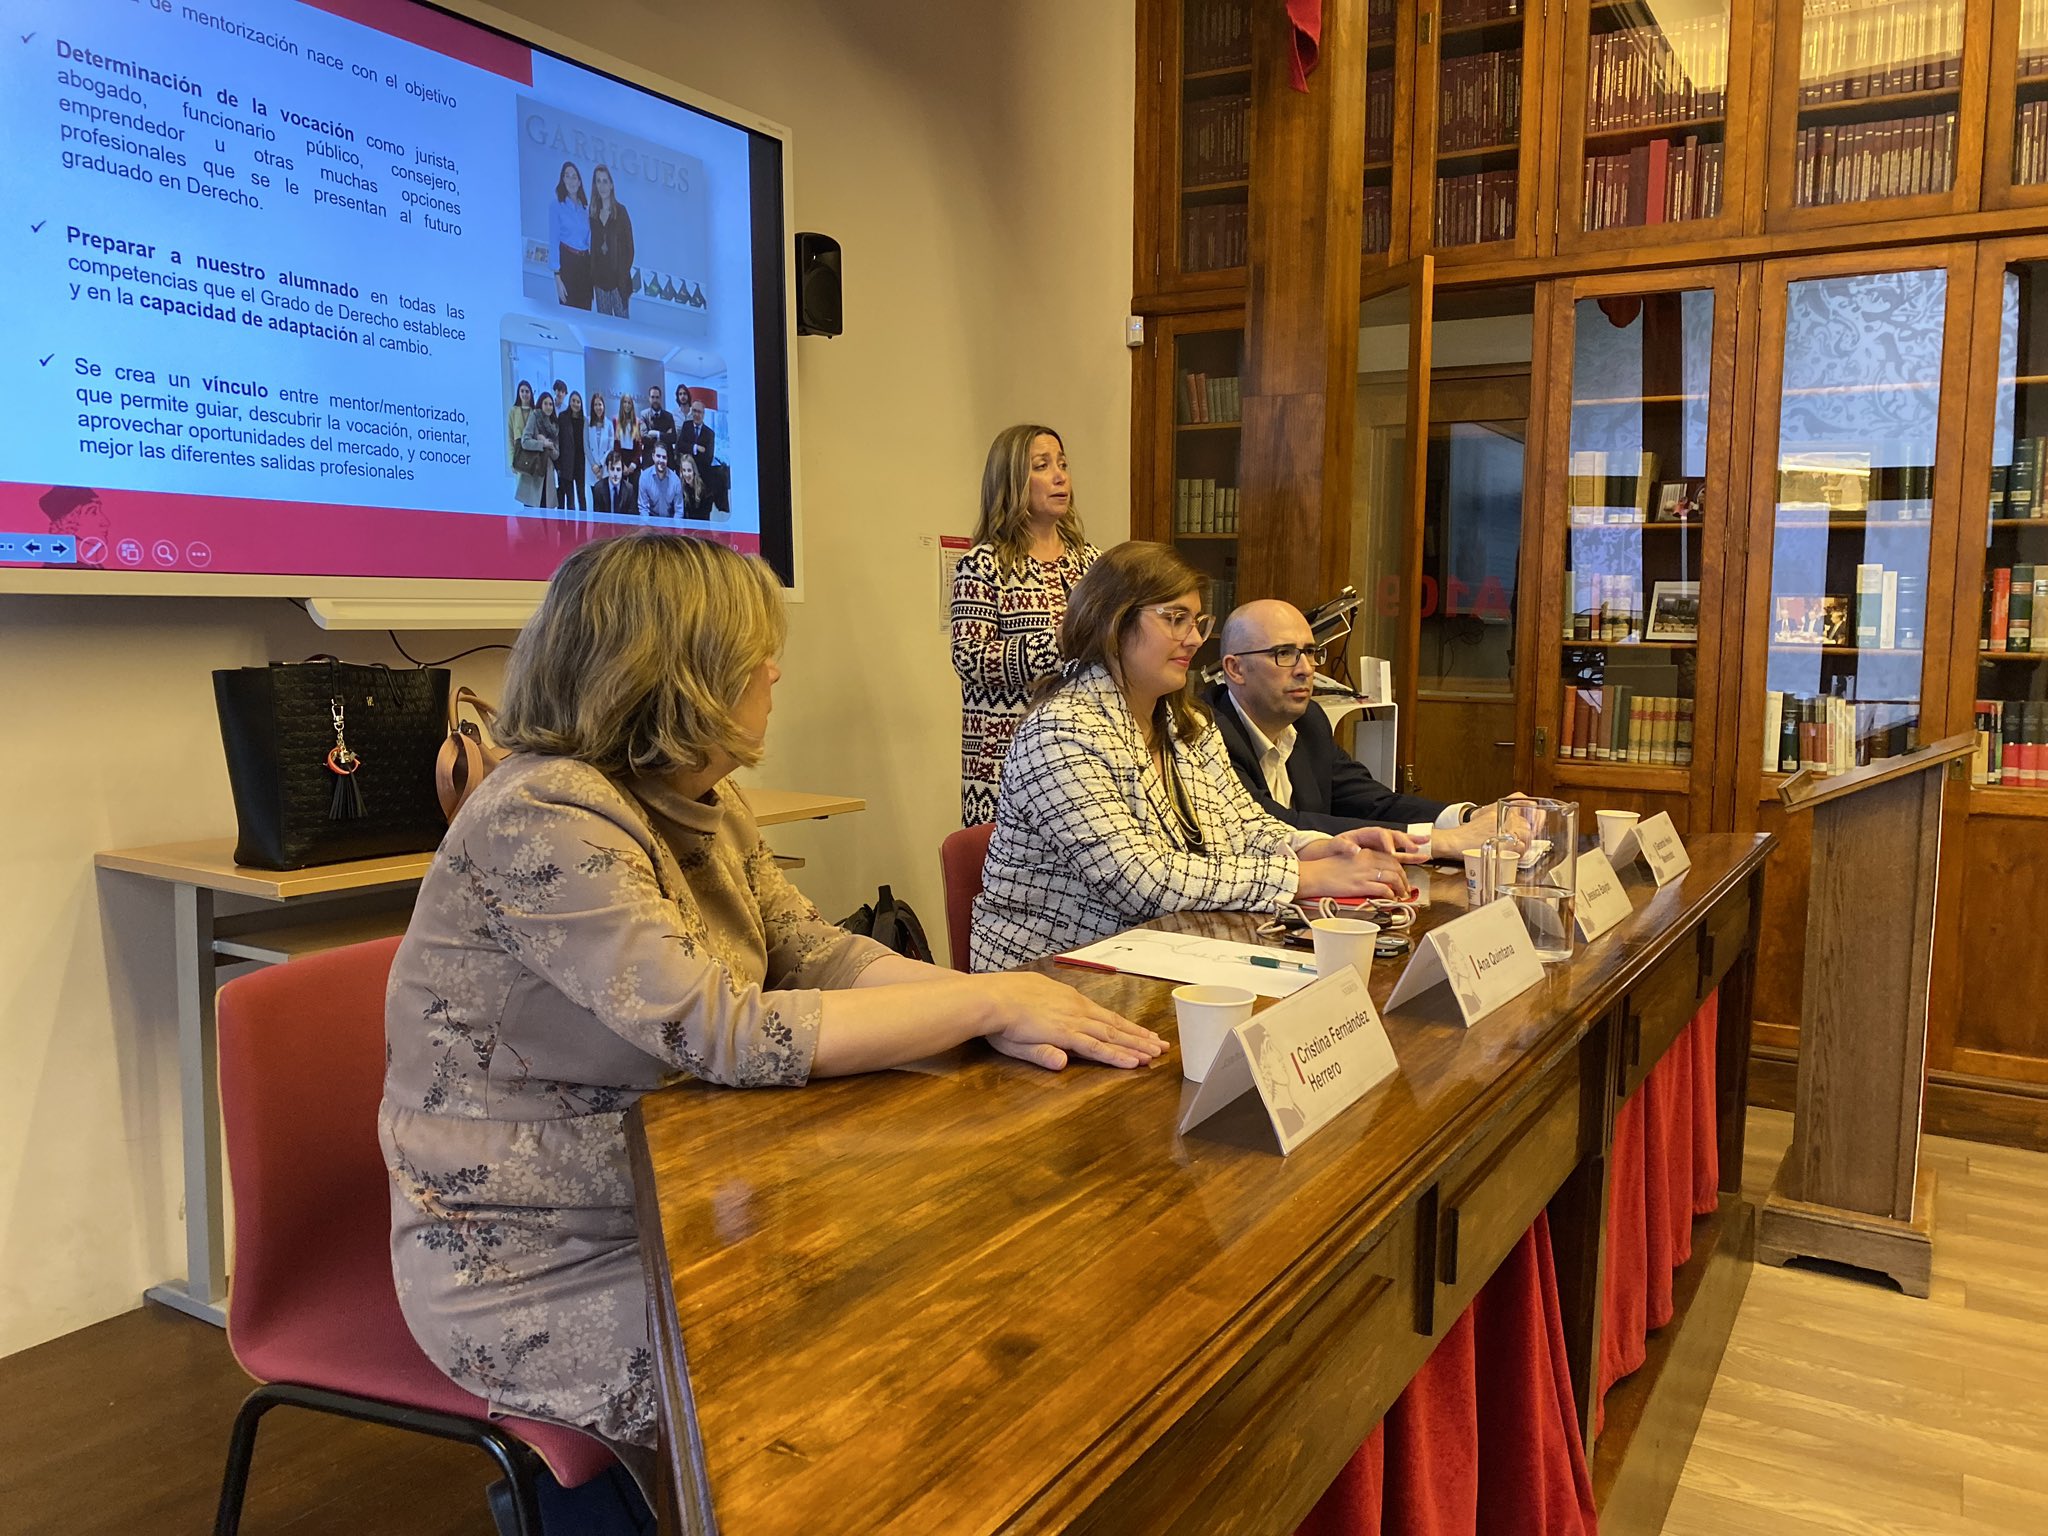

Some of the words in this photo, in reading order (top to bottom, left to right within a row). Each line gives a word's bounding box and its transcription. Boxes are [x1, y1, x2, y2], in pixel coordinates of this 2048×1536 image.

[182, 6, 299, 56] mentorización
[306, 48, 344, 71] nace
[351, 63, 378, 83] con
[385, 73, 398, 90] el
[404, 80, 457, 109] objetivo
[56, 39, 203, 98] Determinación
[216, 88, 239, 108] de
[252, 97, 268, 117] la
[279, 108, 355, 143] vocación
[366, 135, 405, 157] como
[414, 146, 459, 176] jurista,
[57, 68, 147, 110] abogado,
[182, 101, 276, 142] funcionario
[306, 139, 364, 170] público,
[390, 165, 460, 197] consejero,
[58, 97, 186, 142] emprendedor
[214, 138, 225, 153] u
[253, 149, 295, 171] otras
[320, 167, 378, 194] muchas
[401, 190, 461, 216] opciones
[60, 123, 187, 167] profesionales
[203, 160, 236, 180] que
[250, 172, 271, 188] se
[285, 176, 300, 195] le
[313, 188, 387, 218] presentan
[399, 208, 412, 225] al
[423, 213, 462, 236] futuro
[61, 150, 154, 184] graduado
[158, 174, 181, 191] en
[186, 175, 264, 210] Derecho.
[525, 114, 690, 193] GARRIGUES
[66, 225, 156, 259] Preparar
[170, 250, 182, 265] a
[196, 255, 266, 281] nuestro
[278, 270, 359, 300] alumnado
[370, 291, 388, 306] en
[398, 294, 437, 315] todas
[446, 302, 465, 320] las
[67, 257, 199, 293] competencias
[203, 282, 236, 301] que
[240, 286, 256, 304] el
[260, 289, 311, 313] Grado
[314, 299, 334, 318] de
[338, 303, 399, 329] Derecho
[402, 319, 466, 341] establece
[69, 282, 81, 301] y
[86, 286, 111, 303] en
[116, 286, 134, 307] la
[139, 294, 237, 324] capacidad
[241, 309, 264, 328] de
[266, 308, 359, 344] adaptación
[362, 331, 375, 347] al
[379, 336, 432, 357] cambio.
[74, 357, 102, 378] Se
[114, 367, 156, 385] crea
[168, 373, 191, 389] un
[201, 375, 269, 399] vínculo
[278, 388, 319, 405] entre
[329, 395, 469, 428] mentor/mentorizado,
[75, 387, 113, 407] que
[119, 392, 189, 414] permite
[194, 400, 243, 422] guiar,
[248, 404, 323, 429] descubrir
[327, 413, 341, 431] la
[345, 419, 413, 441] vocación,
[417, 425, 470, 448] orientar,
[77, 413, 185, 437] aprovechar
[187, 425, 306, 450] oportunidades
[309, 434, 333, 452] del
[337, 441, 404, 462] mercado,
[407, 448, 416, 464] y
[419, 449, 472, 465] conocer
[79, 437, 135, 460] mejor
[138, 440, 166, 460] las
[170, 443, 256, 468] diferentes
[259, 453, 316, 473] salidas
[319, 459, 415, 481] profesionales
[1476, 958, 1491, 973] Ana
[1488, 944, 1515, 966] Quintana
[1296, 1034, 1332, 1065] Cristina
[1328, 1009, 1371, 1047] Fernández
[1307, 1060, 1343, 1093] Herrero
